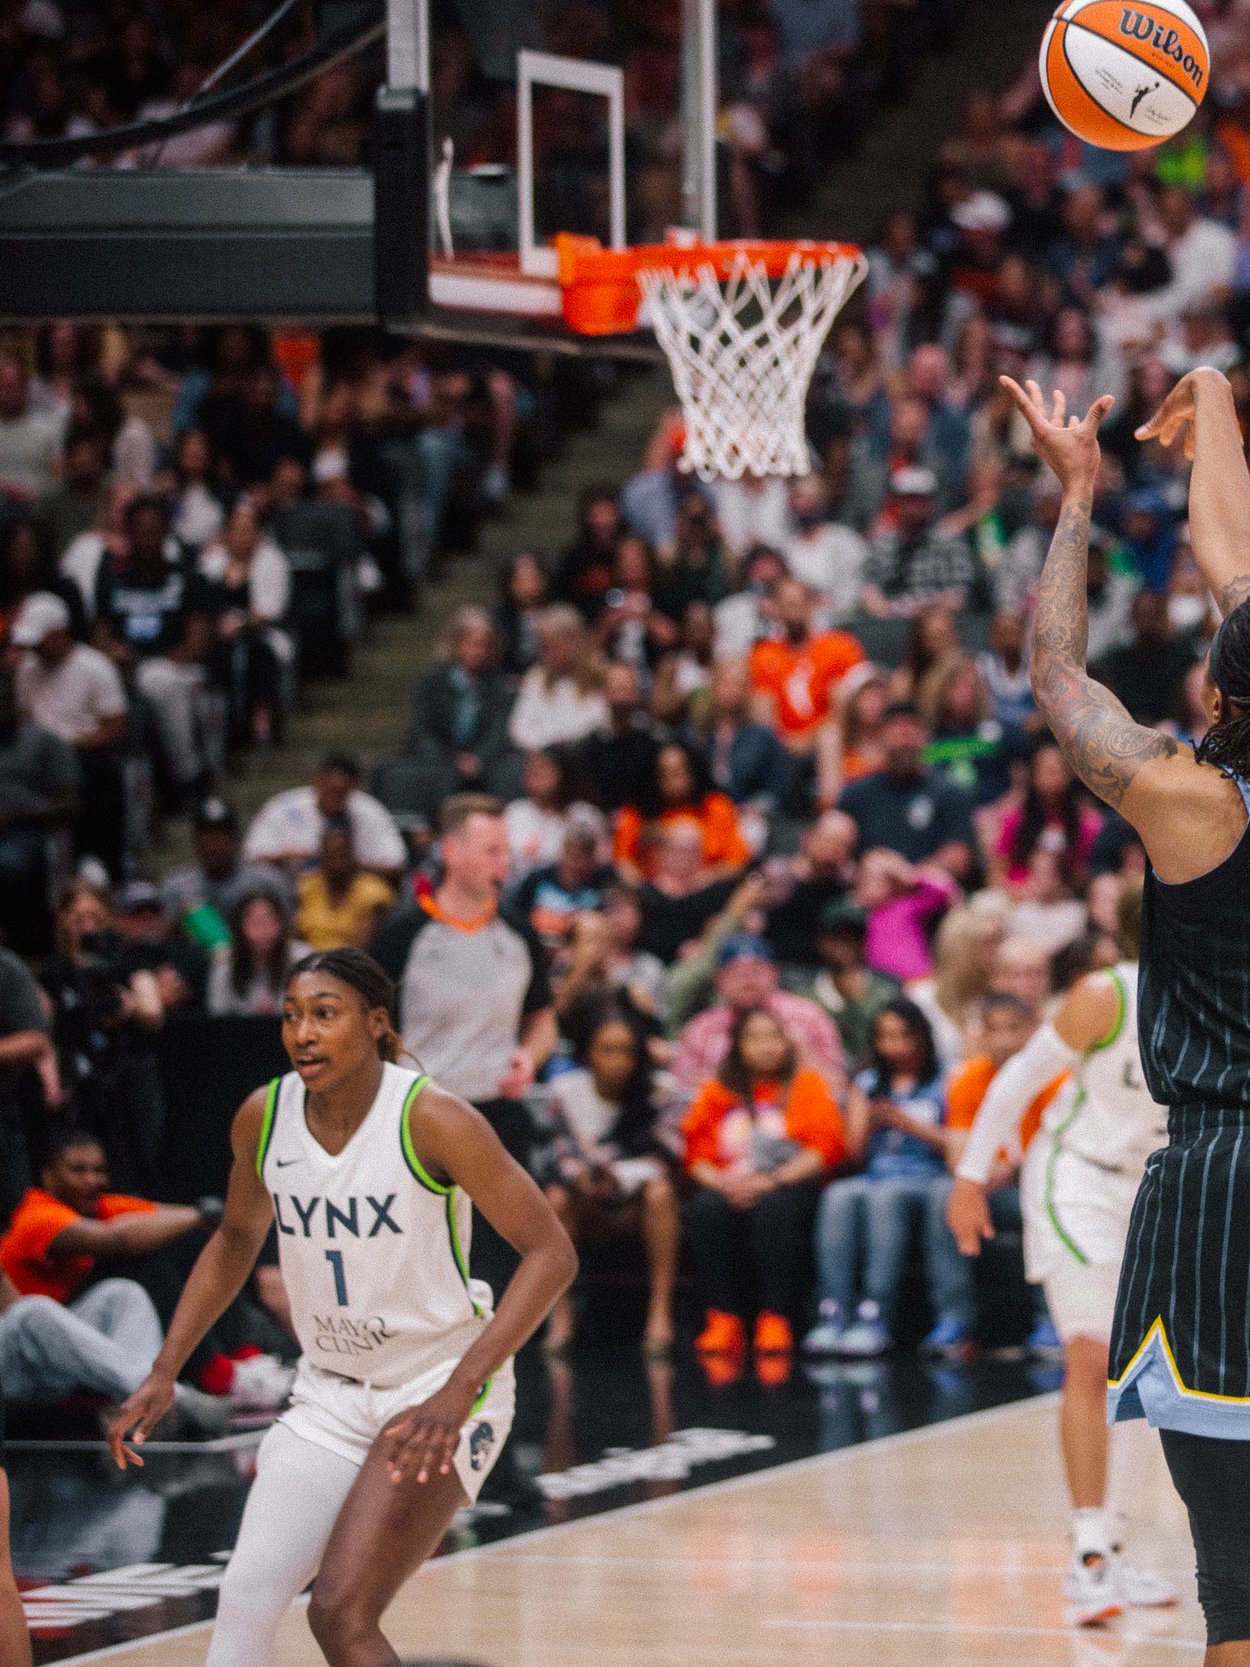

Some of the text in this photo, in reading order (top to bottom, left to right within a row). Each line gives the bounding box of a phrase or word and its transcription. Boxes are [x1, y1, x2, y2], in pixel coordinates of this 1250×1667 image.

[1120, 8, 1203, 88] Wilson
[272, 1193, 404, 1239] LYNX
[325, 1249, 349, 1307] 1
